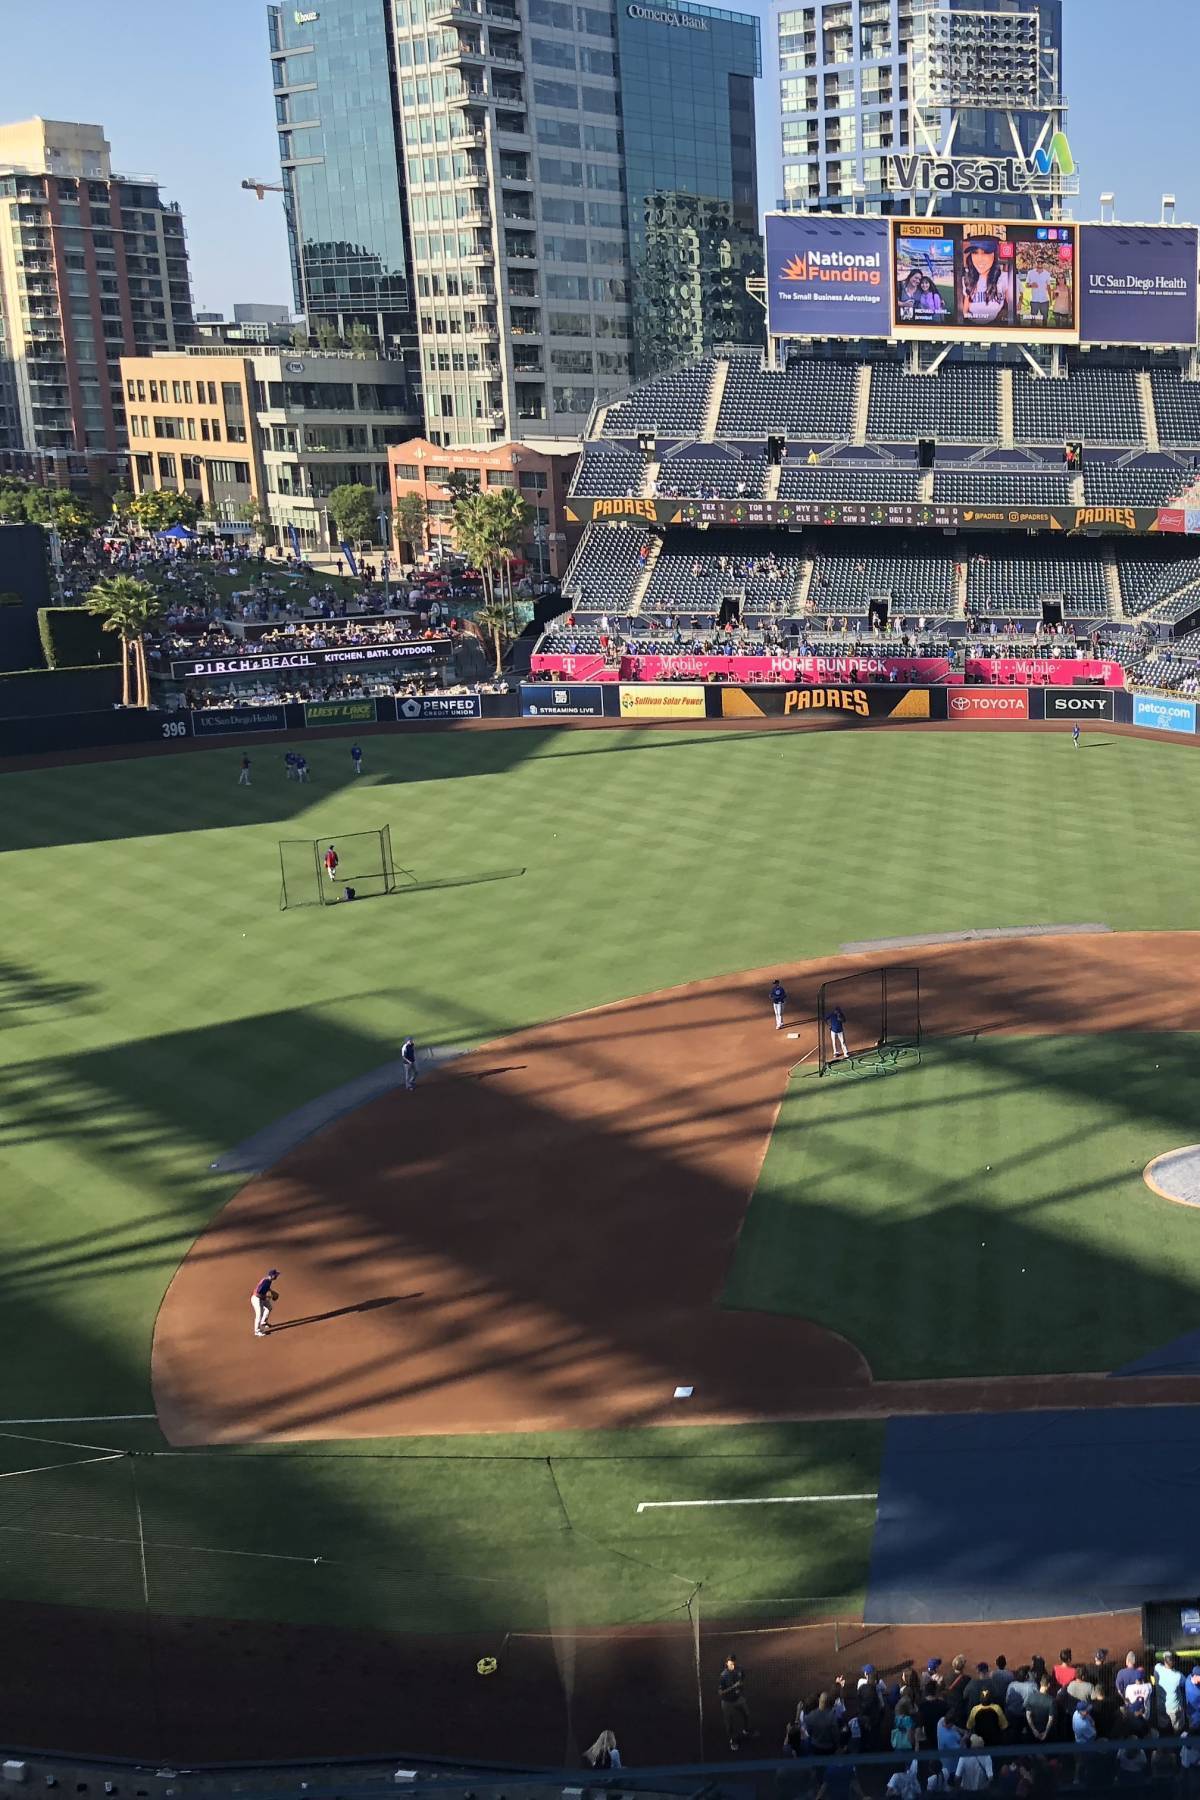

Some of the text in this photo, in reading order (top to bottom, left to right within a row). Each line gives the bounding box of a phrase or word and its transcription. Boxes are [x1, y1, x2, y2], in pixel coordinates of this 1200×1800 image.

[682, 14, 708, 30] Bank
[892, 154, 1022, 193] Viasat
[962, 224, 1007, 241] PADRES
[808, 251, 880, 267] National
[808, 266, 881, 285] Funding
[1089, 274, 1187, 290] UC San Diego Health
[778, 292, 881, 304] The Small Business Advantage
[592, 499, 657, 521] PADRES
[974, 512, 1004, 520] @PADRES
[1020, 513, 1049, 521] @PADRES
[796, 514, 811, 522] CLE
[1074, 508, 1136, 529] PADRES
[324, 646, 436, 662] KITCHEN. BATH. OUTDOOR.
[194, 660, 249, 674] PIRCH
[262, 655, 309, 668] BEACH
[660, 656, 703, 671] Mobile
[772, 658, 887, 672] HOME RUN DECK
[1015, 661, 1056, 674] Mobile
[424, 700, 474, 710] PENFED
[634, 696, 661, 705] Sullivan
[662, 696, 682, 705] Solar
[784, 688, 870, 717] PADRES
[972, 698, 1024, 710] TOYOTA
[1055, 700, 1107, 710] SONY
[1138, 703, 1190, 718] petco.com
[162, 722, 186, 738] 396
